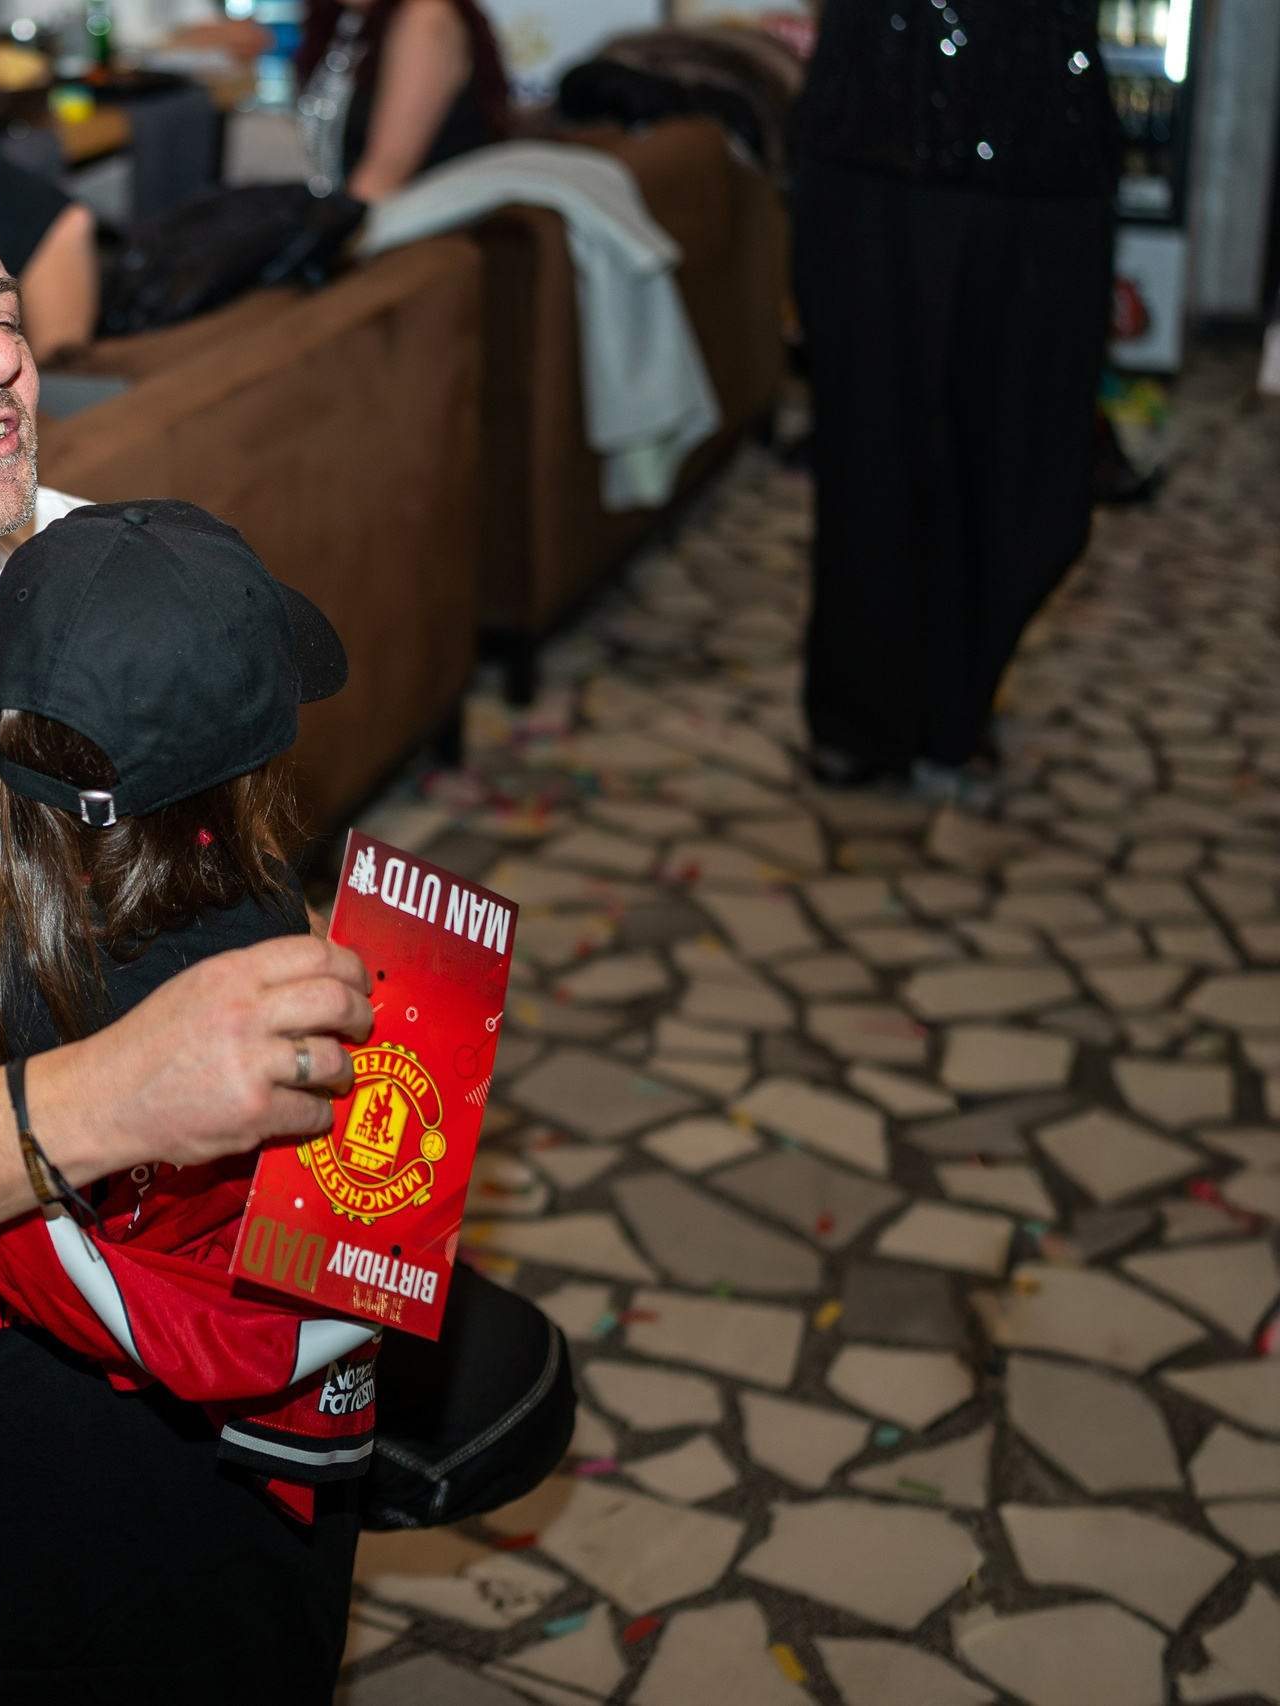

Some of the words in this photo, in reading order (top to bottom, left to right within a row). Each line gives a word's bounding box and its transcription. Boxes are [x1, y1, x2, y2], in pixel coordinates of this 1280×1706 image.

[380, 857, 442, 924] UTD
[444, 884, 511, 955] MAN
[353, 1051, 429, 1099] UNITED
[310, 1134, 423, 1210] MANCHESTER
[244, 1216, 327, 1292] DAD
[326, 1239, 438, 1304] BIRTHDAY
[318, 1386, 352, 1414] for
